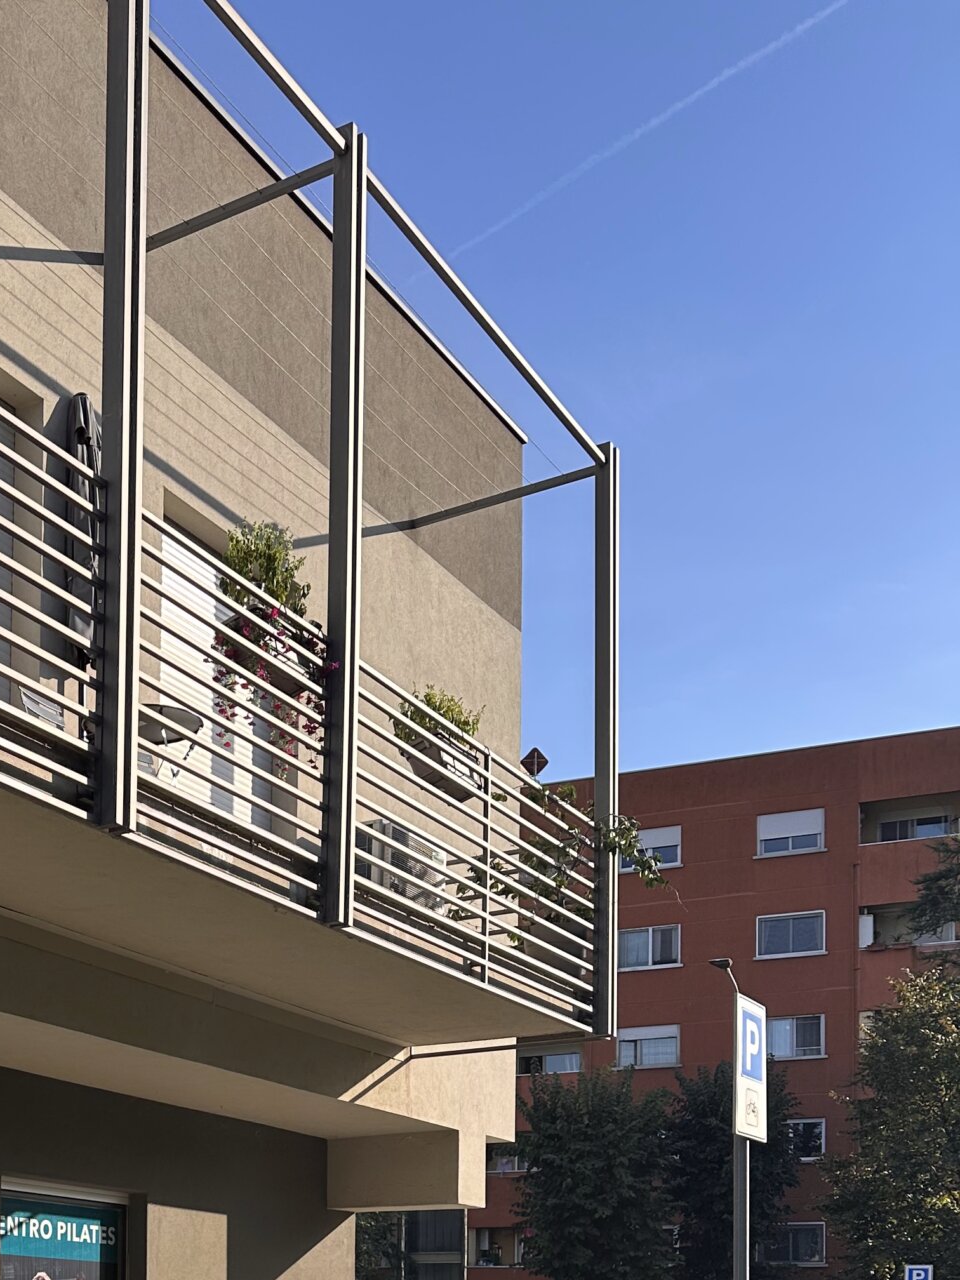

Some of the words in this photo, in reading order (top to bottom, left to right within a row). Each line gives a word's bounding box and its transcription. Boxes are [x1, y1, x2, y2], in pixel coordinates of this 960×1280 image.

[746, 1018, 759, 1071] P
[0, 1215, 53, 1240] ENTRO
[57, 1221, 116, 1245] PILATES
